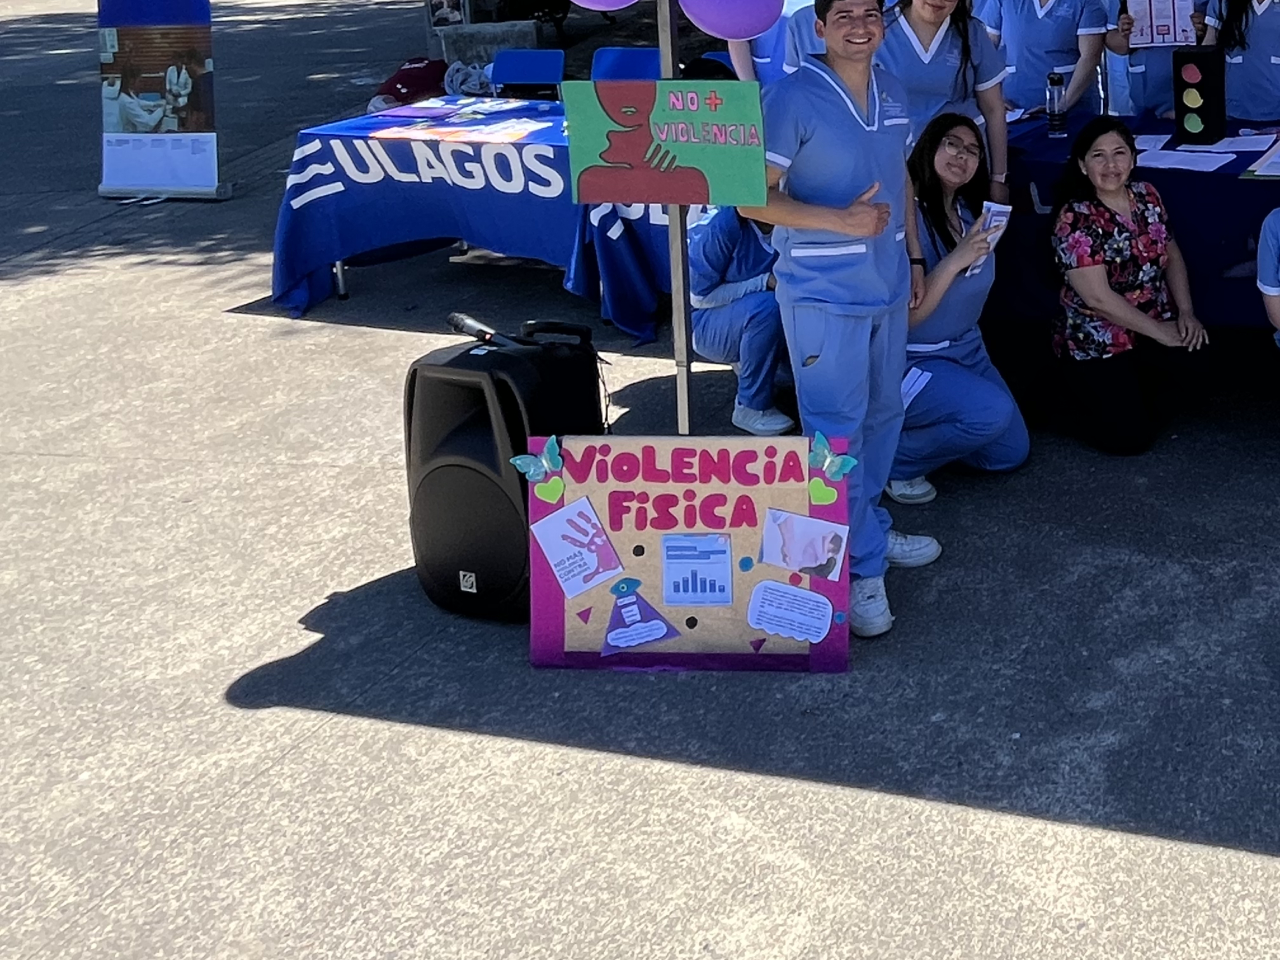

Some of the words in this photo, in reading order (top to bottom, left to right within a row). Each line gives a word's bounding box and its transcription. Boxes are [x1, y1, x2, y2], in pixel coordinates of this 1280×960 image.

[668, 90, 700, 112] NO
[653, 122, 761, 147] VIOLENCIA
[329, 138, 565, 199] ULAGOS
